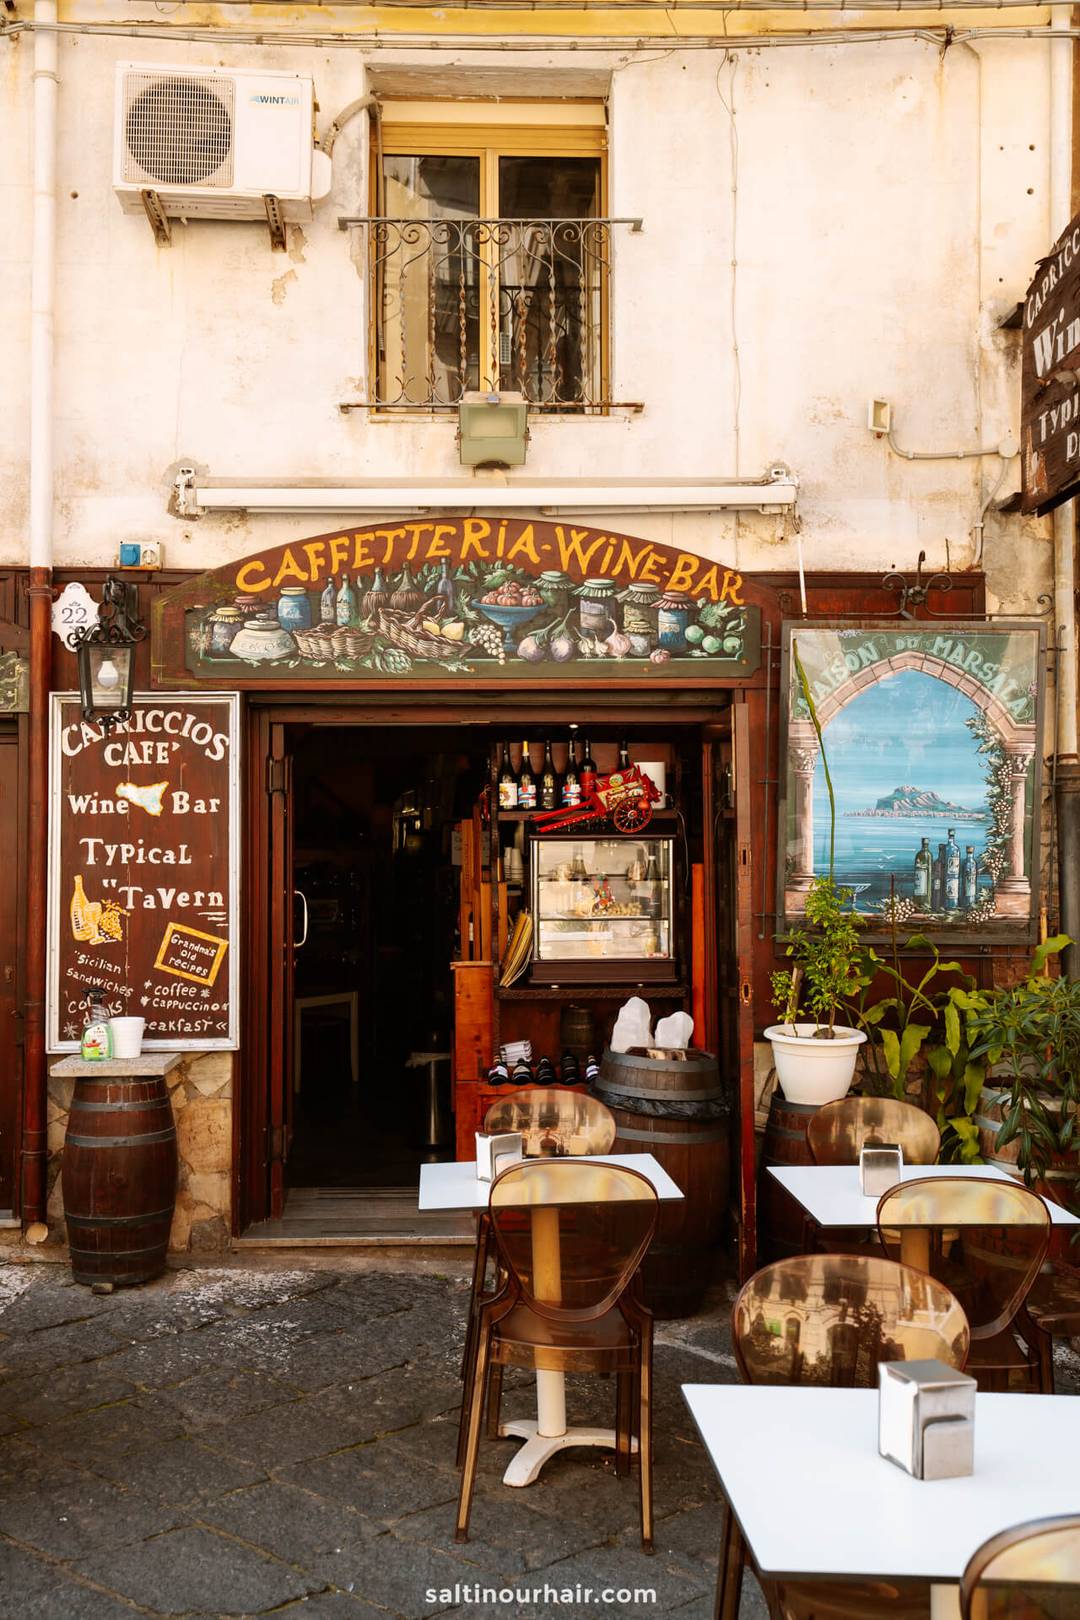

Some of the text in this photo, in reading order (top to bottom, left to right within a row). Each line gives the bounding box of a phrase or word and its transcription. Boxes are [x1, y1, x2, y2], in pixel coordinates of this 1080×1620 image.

[1066, 432, 1080, 462] D
[61, 607, 88, 624] 22
[932, 636, 1028, 717] MARSALA
[68, 791, 221, 815] Wine Bar
[168, 956, 209, 977] recipes
[154, 983, 198, 997] coffee
